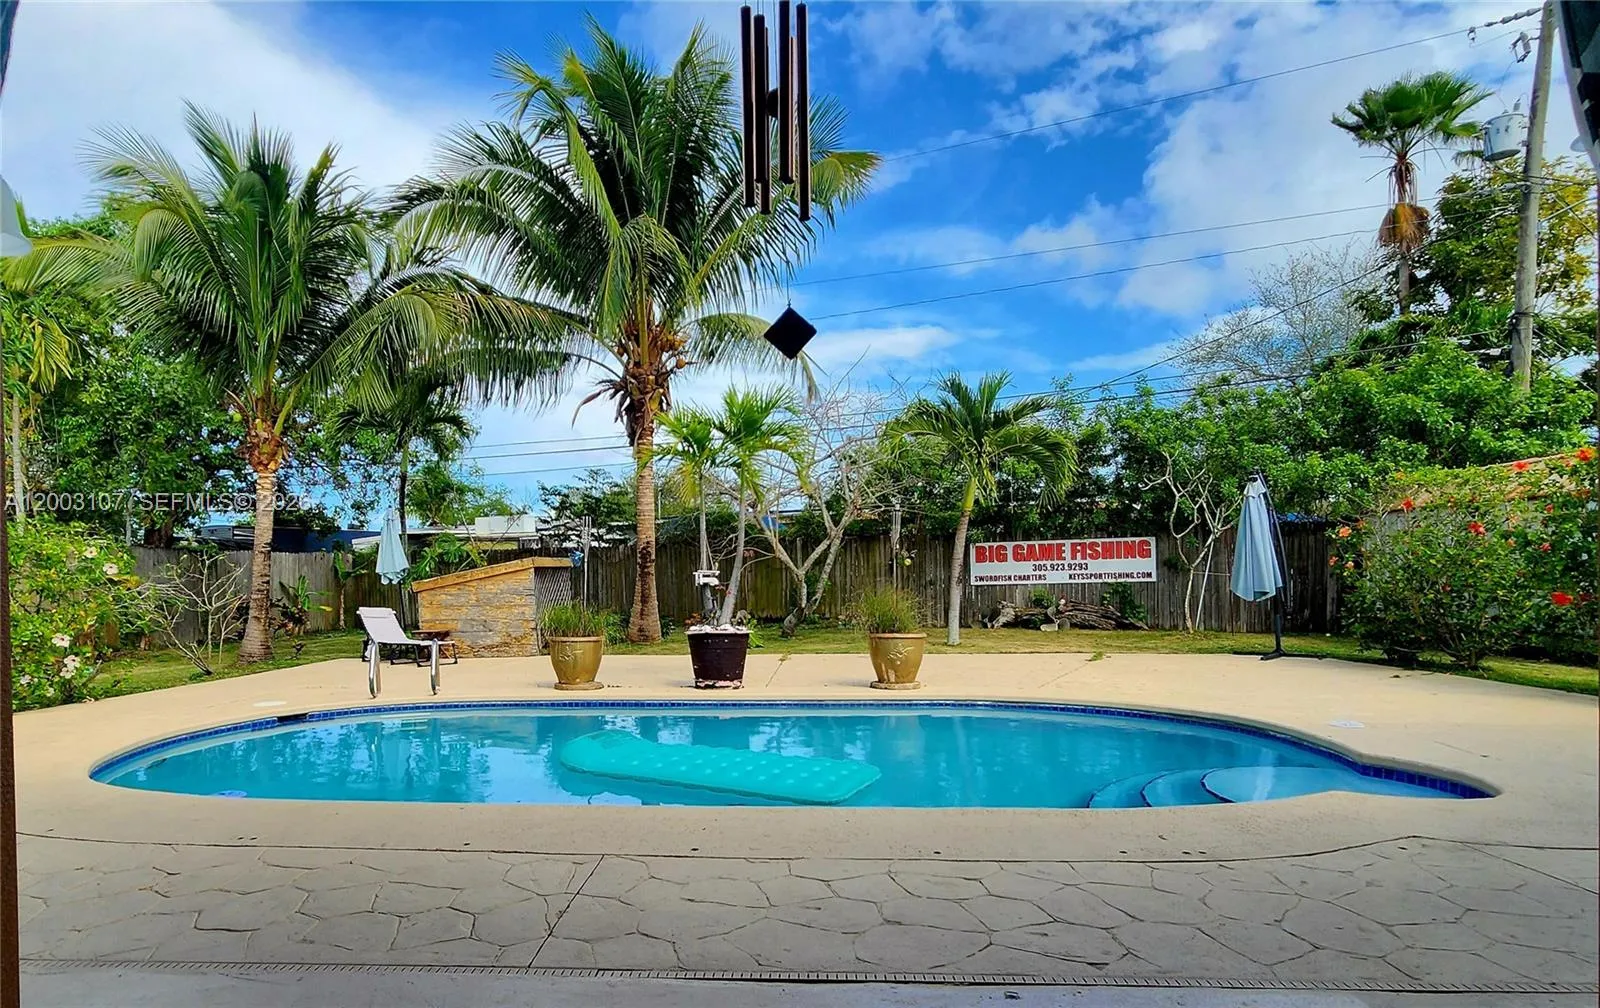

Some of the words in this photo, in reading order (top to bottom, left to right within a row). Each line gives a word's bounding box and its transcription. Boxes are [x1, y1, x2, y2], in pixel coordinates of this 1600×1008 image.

[975, 544, 1008, 563] BIG
[1012, 542, 1066, 562] GAME
[1070, 539, 1152, 561] FISHING
[1032, 562, 1088, 572] 305.923.9293
[1068, 572, 1152, 580] KEYSSPORTFISHING.COM
